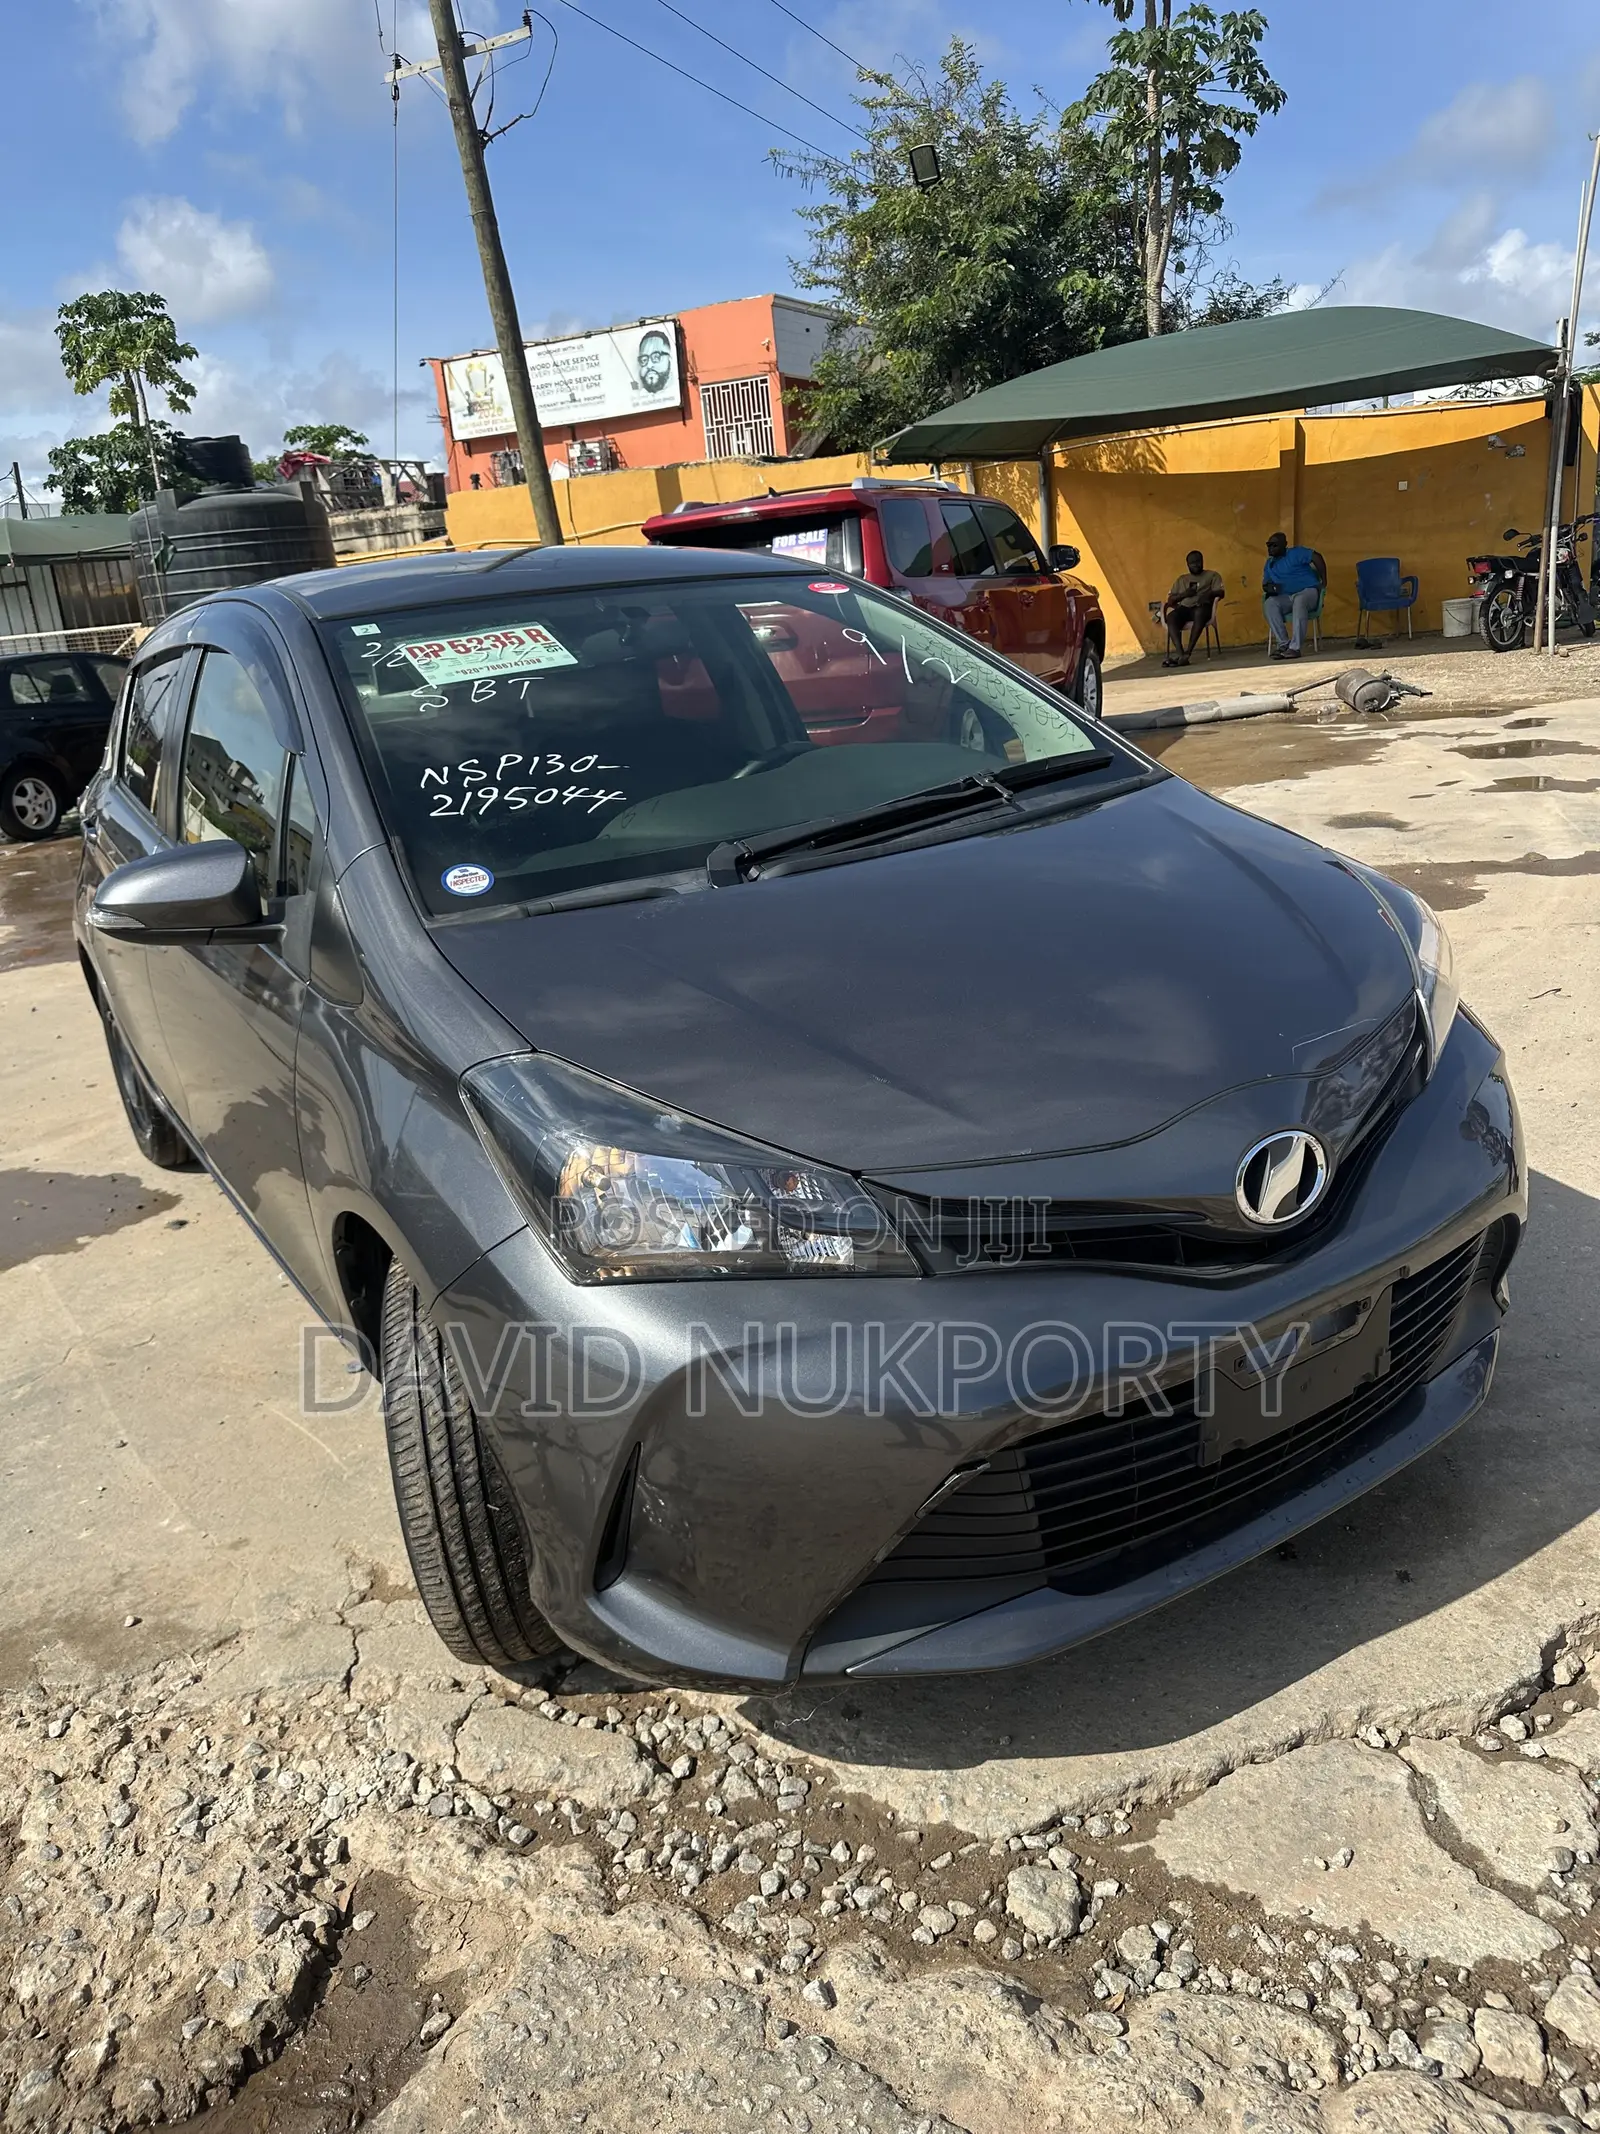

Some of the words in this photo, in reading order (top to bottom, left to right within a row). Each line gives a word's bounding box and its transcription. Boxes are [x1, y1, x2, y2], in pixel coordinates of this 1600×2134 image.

[530, 362, 551, 372] WORD
[553, 358, 571, 368] ALIVE
[572, 353, 600, 365] SERVICE
[531, 370, 551, 380] EVERY
[553, 365, 579, 376] SUNDAY
[586, 361, 600, 370] 7AM
[534, 388, 554, 399] EVERY
[586, 381, 601, 390] 6PM
[555, 378, 573, 388] HOUR
[575, 373, 602, 385] SERVICE
[774, 534, 797, 549] FOR
[798, 528, 826, 545] SALE
[447, 630, 526, 655] 5235
[523, 627, 551, 644] R
[430, 786, 627, 817] 2195044
[450, 874, 488, 887] INSPECTED
